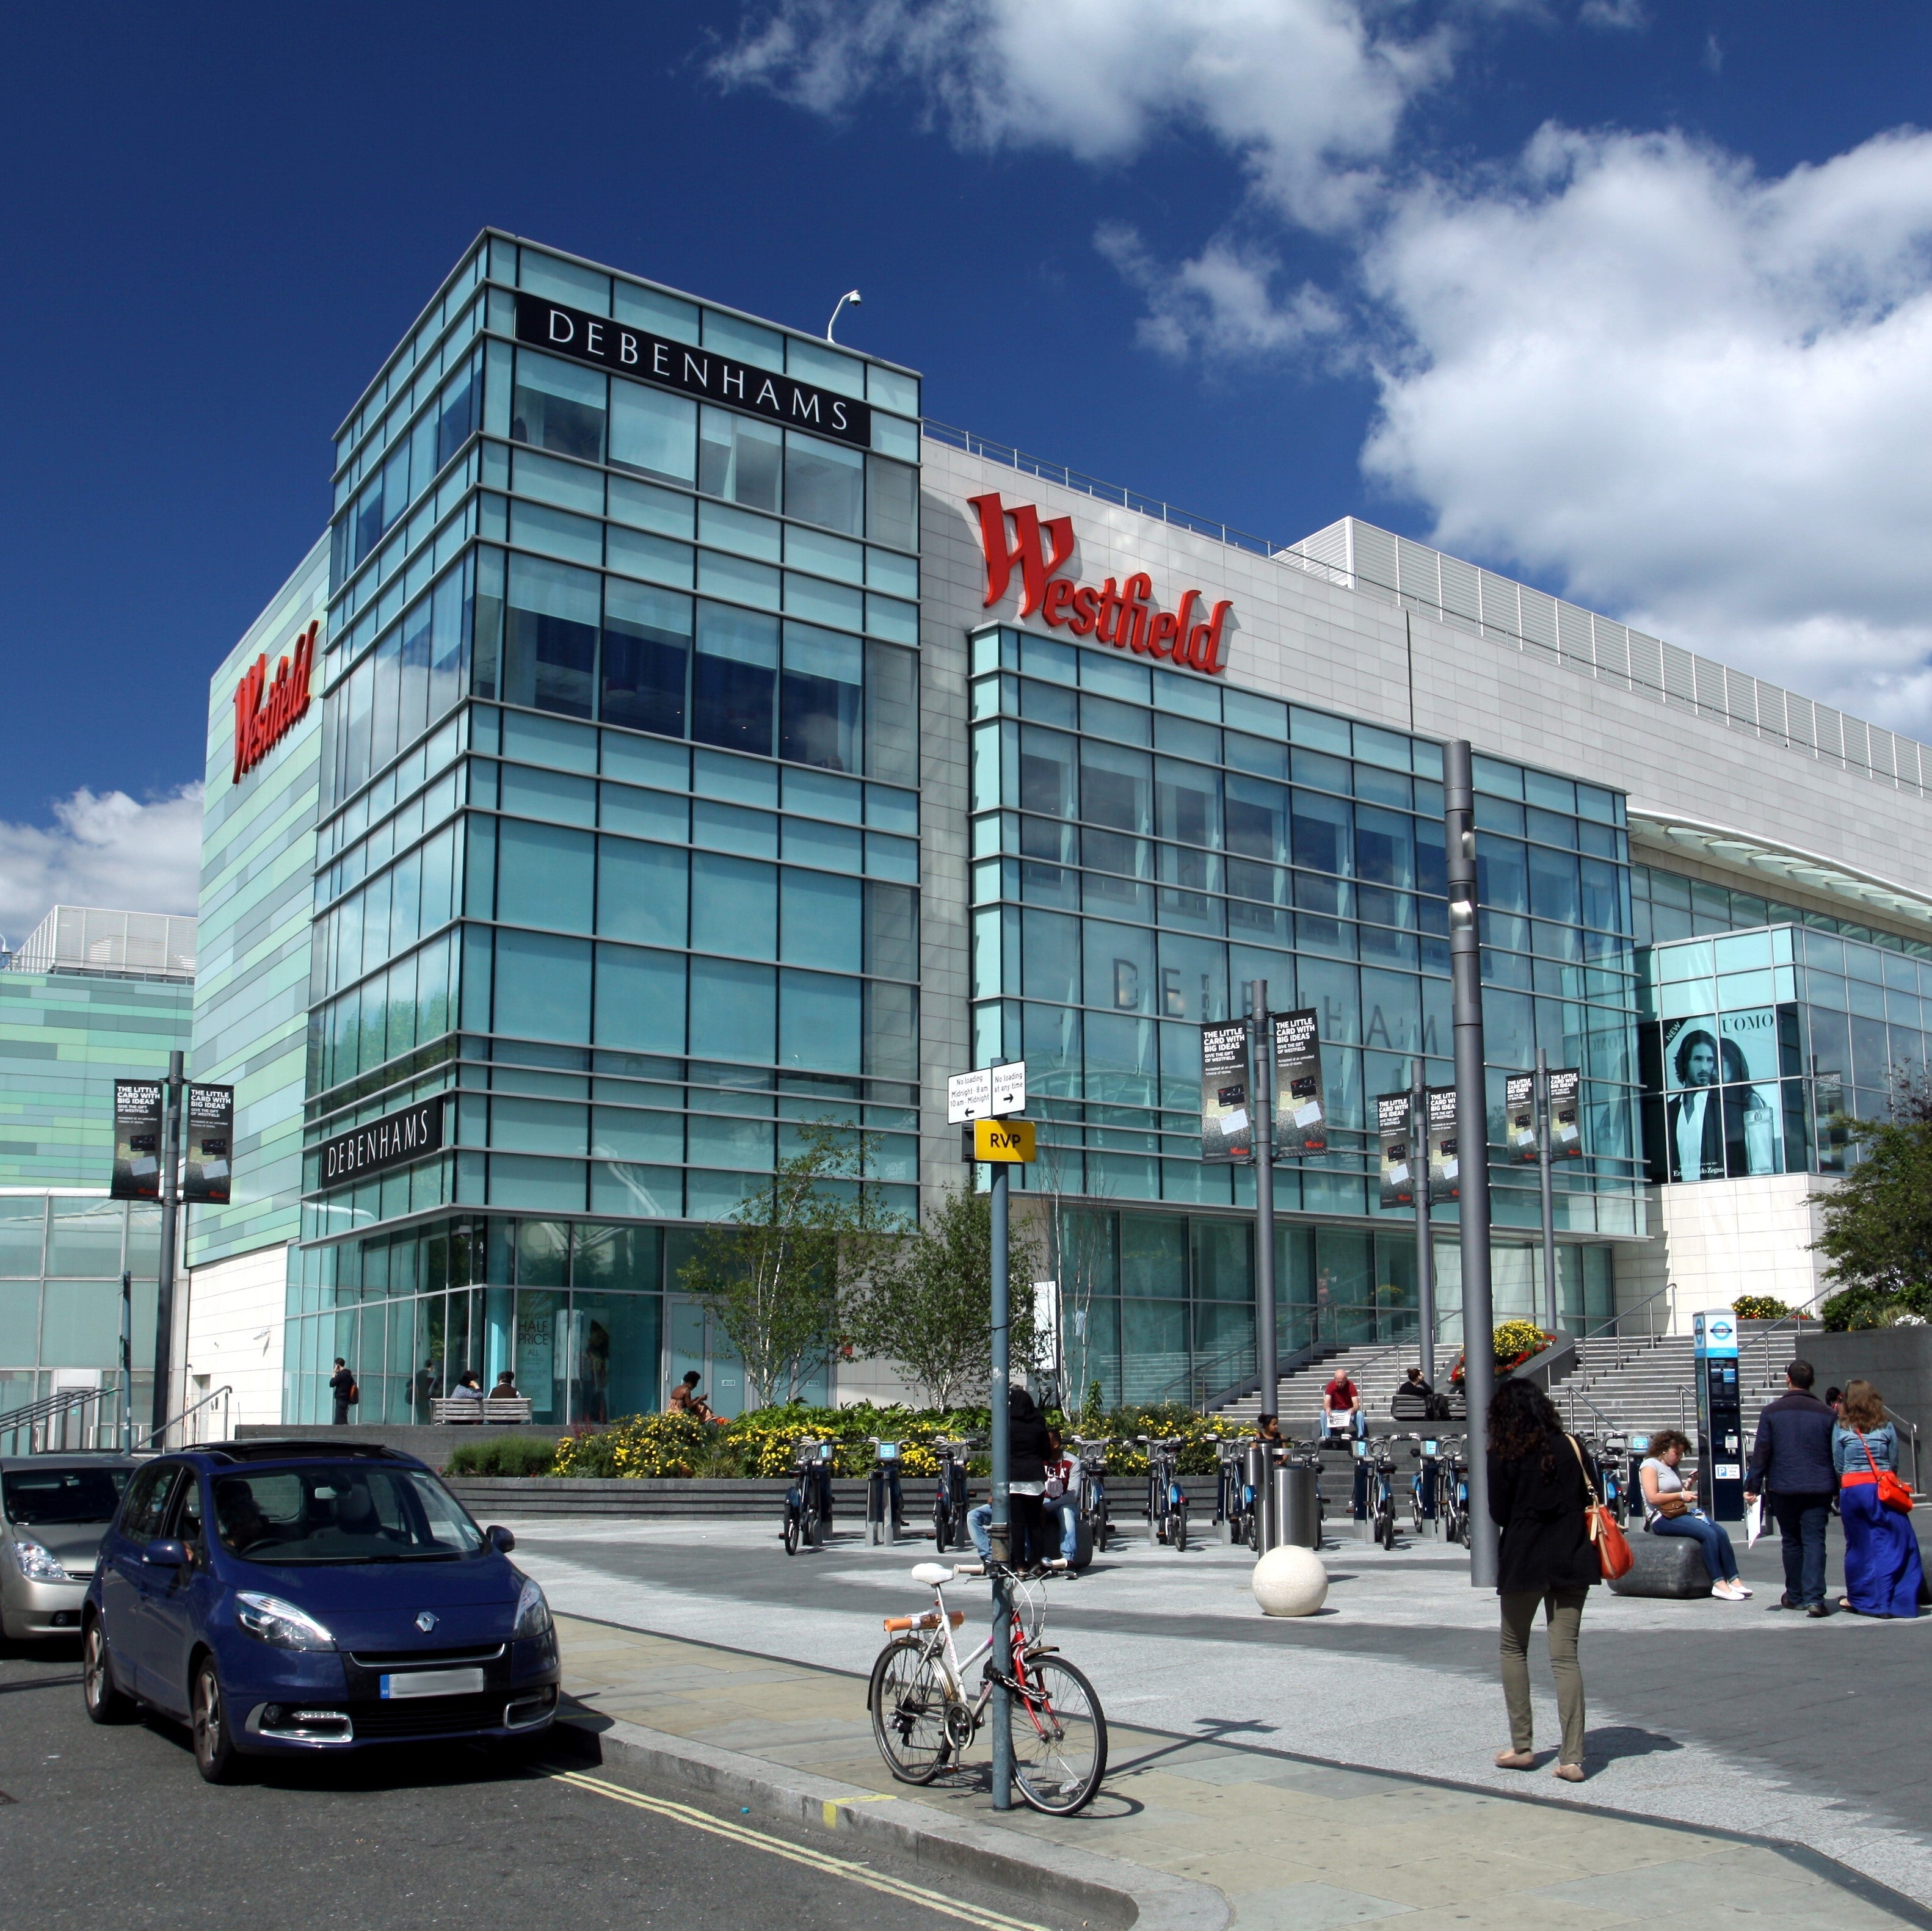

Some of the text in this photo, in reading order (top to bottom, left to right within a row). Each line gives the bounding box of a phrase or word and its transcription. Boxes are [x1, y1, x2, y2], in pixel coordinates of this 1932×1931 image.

[549, 309, 848, 430] DEBENHAMS
[966, 492, 1233, 675] Westfield
[232, 620, 319, 784] Westfield
[1276, 1017, 1312, 1029] THE LITTLE
[1722, 1013, 1774, 1033] UOMO
[1204, 1027, 1243, 1039] THE LITTLE
[1276, 1024, 1315, 1036] CARD WITH
[1665, 1021, 1680, 1041] NEW
[1204, 1034, 1245, 1046] CARD WITH
[1277, 1032, 1310, 1044] BIG IDEAS
[1218, 1042, 1240, 1051] IDEAS
[1004, 1073, 1022, 1081] loading
[951, 1088, 973, 1098] Midnight
[968, 1093, 989, 1104] Midnight
[328, 1110, 427, 1177] DEBENHAMS
[990, 1133, 1021, 1148] RVP
[518, 1320, 547, 1332] HALF
[518, 1333, 547, 1345] PRICE
